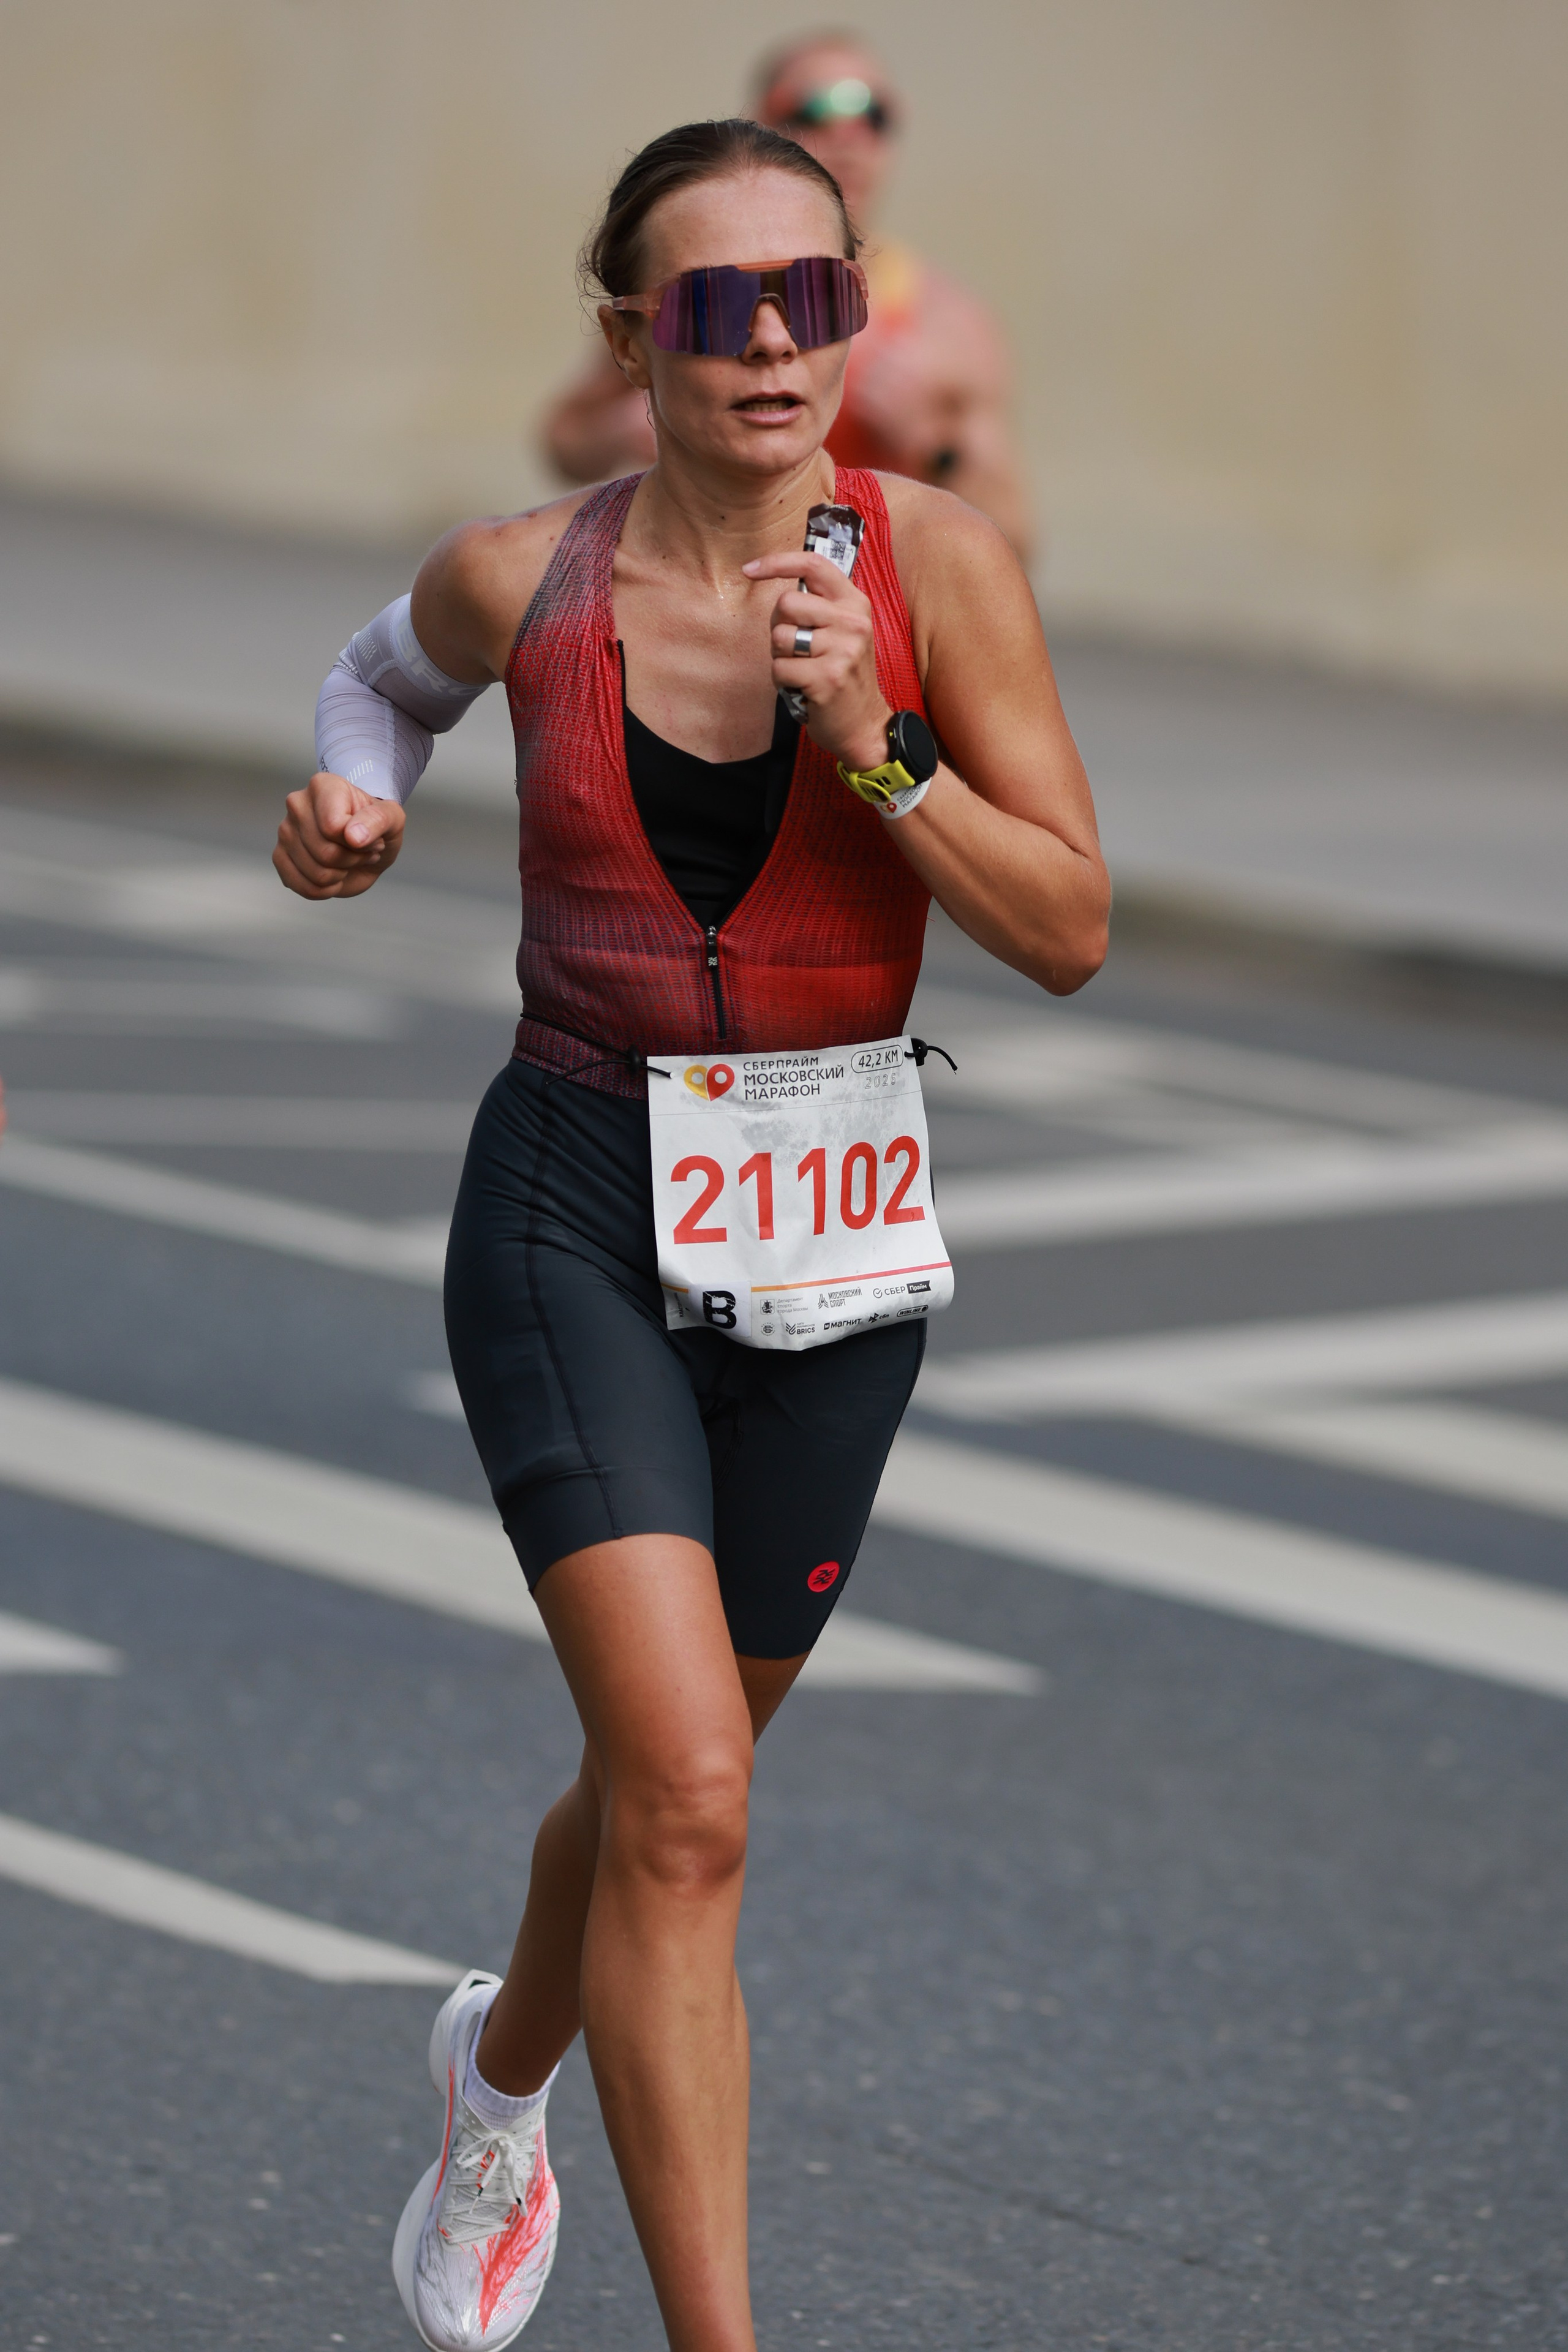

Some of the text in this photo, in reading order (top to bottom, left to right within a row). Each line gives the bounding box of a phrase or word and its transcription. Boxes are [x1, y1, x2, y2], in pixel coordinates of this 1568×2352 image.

[743, 1056, 819, 1071] СБЕРПРАЙМ
[858, 1049, 899, 1068] 42,2 КМ
[744, 1065, 844, 1086] МОСКОВСКИЙ
[865, 1072, 896, 1089] 2026
[745, 1084, 820, 1101] МАРАФОН
[670, 1136, 925, 1245] 21102
[828, 1287, 862, 1299] МОСКОВСКИЙ
[884, 1283, 927, 1295] СБЕР Прайм
[703, 1290, 737, 1329] B
[829, 1298, 846, 1308] СПОРТ
[899, 1307, 922, 1316] WINLINE
